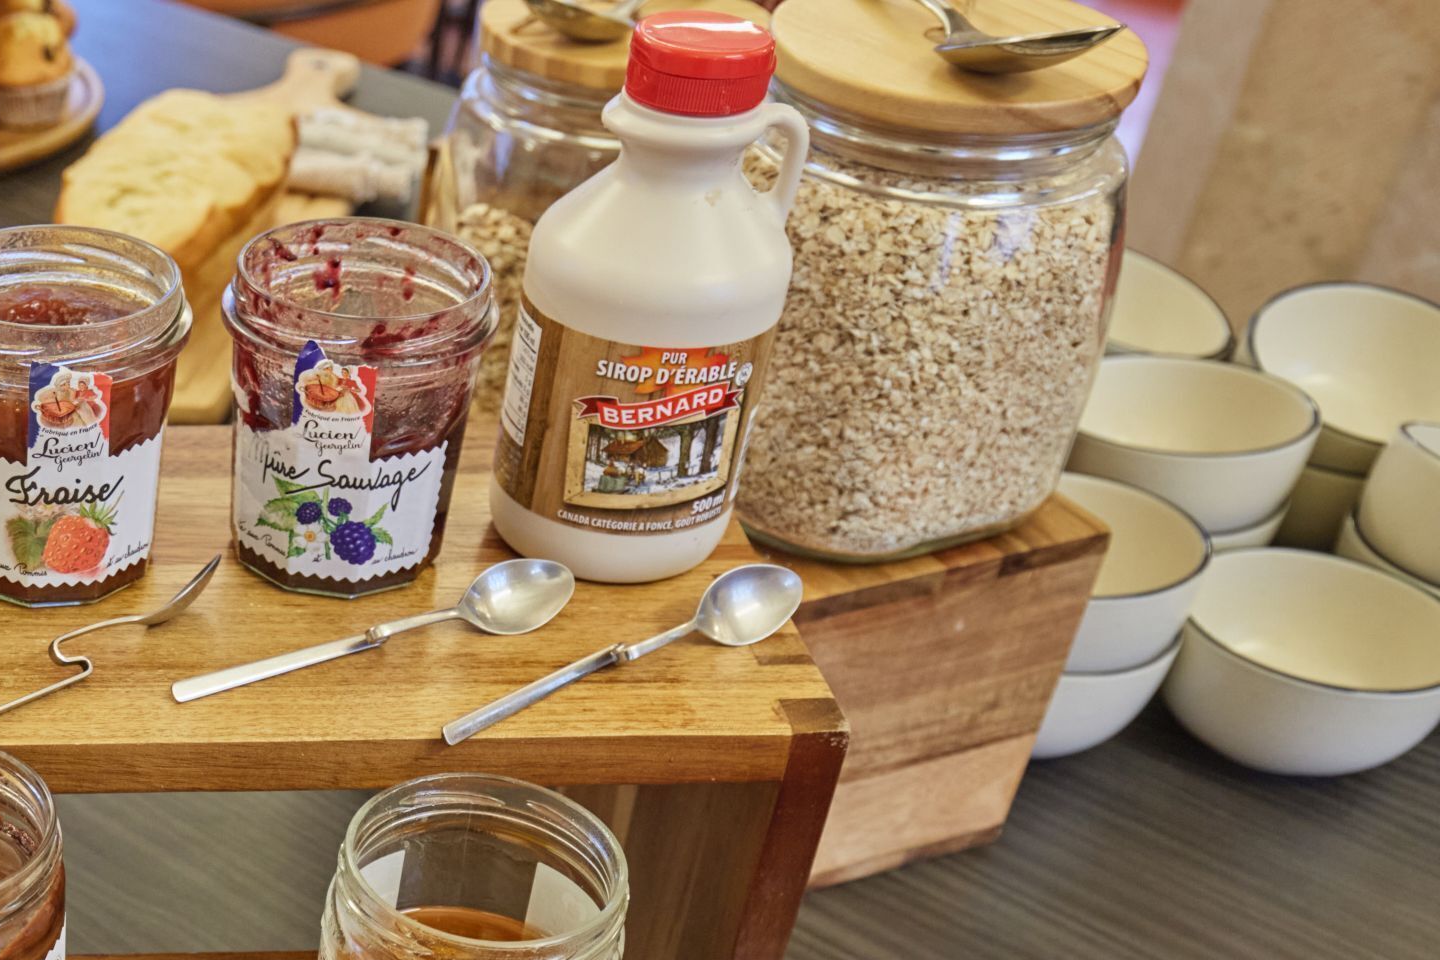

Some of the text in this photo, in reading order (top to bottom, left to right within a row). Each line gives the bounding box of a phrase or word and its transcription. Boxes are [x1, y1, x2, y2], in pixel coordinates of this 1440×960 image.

[661, 352, 688, 365] PUR
[596, 359, 653, 383] SIROP
[655, 361, 738, 385] D'ÉRABLE
[602, 388, 723, 425] BERNARD
[41, 427, 69, 437] Fabriqué
[78, 423, 98, 434] France
[303, 419, 362, 442] Lucien
[31, 431, 101, 459] Lucien
[315, 436, 366, 457] Georgelin
[54, 441, 105, 473] Georgelin
[5, 465, 124, 507] Fraise
[286, 460, 431, 512] Sauvage
[557, 509, 590, 525] CANADA
[690, 496, 713, 515] 500
[14, 562, 48, 577] Pommes
